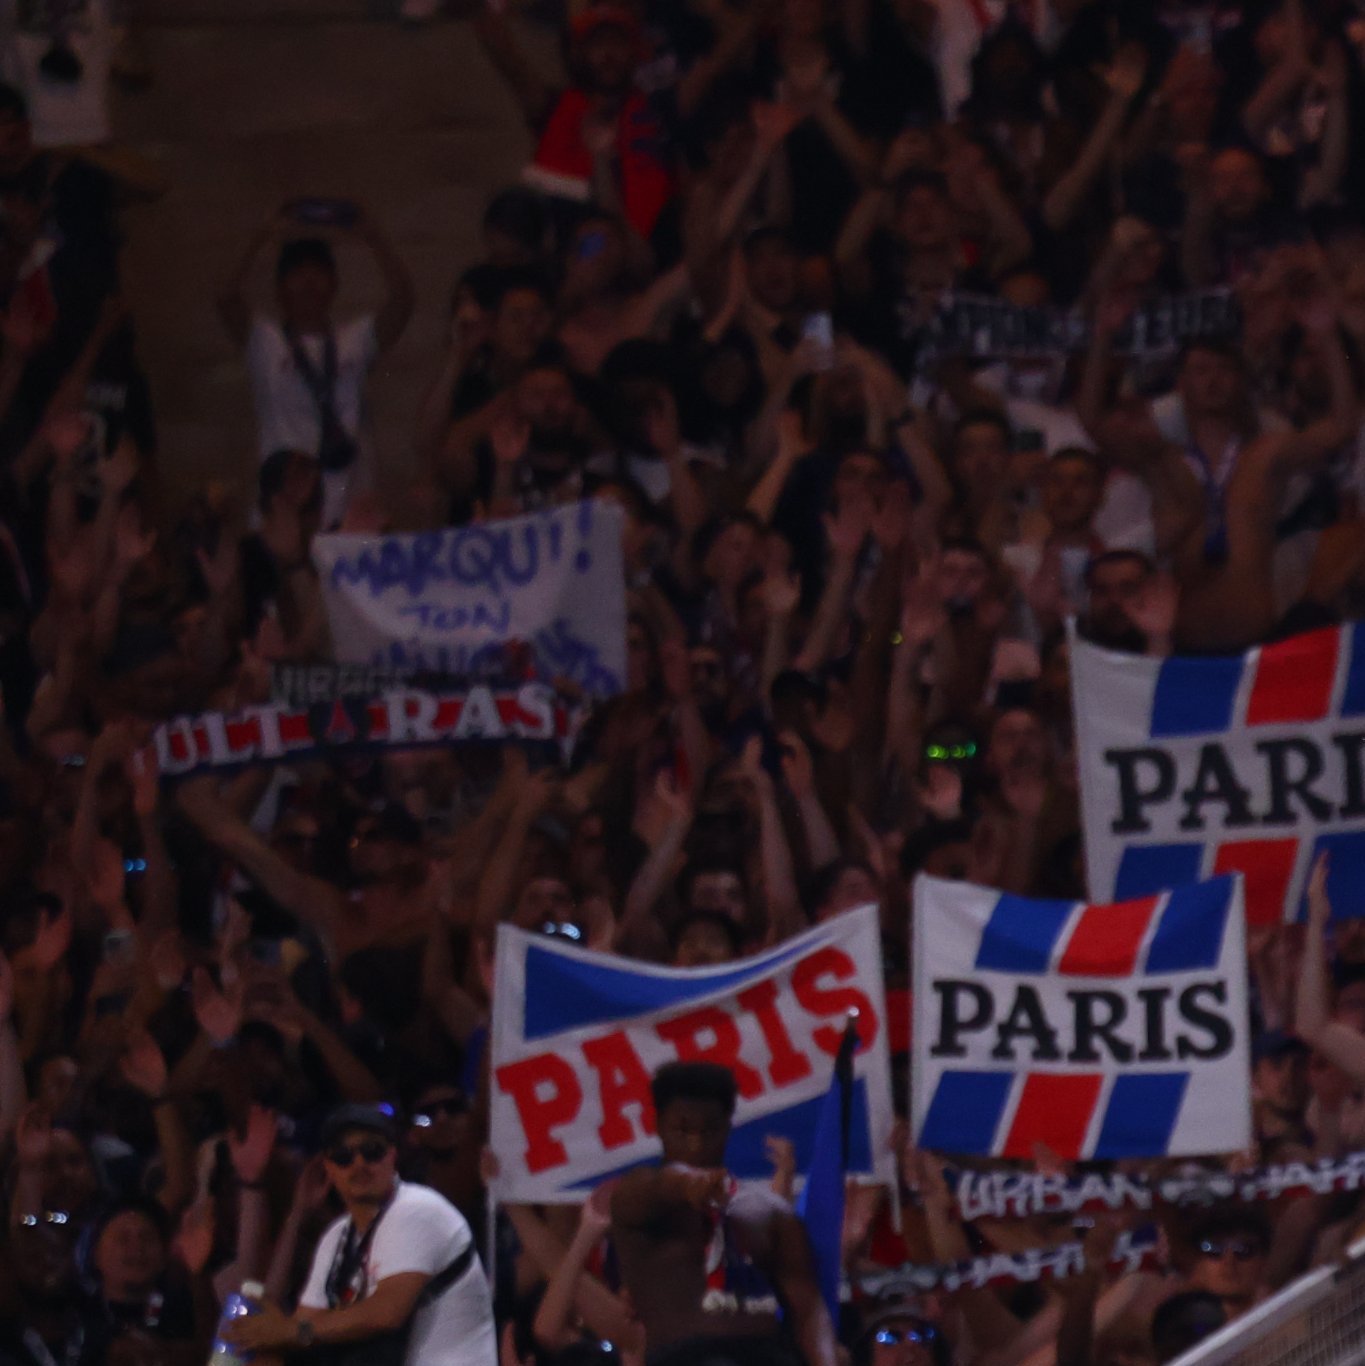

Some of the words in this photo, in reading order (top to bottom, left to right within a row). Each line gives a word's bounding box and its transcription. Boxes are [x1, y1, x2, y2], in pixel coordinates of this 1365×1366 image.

[400, 602, 510, 632] TON
[930, 977, 1234, 1064] PARIS
[495, 947, 879, 1174] PARIS
[957, 1170, 1152, 1222] URBAN
